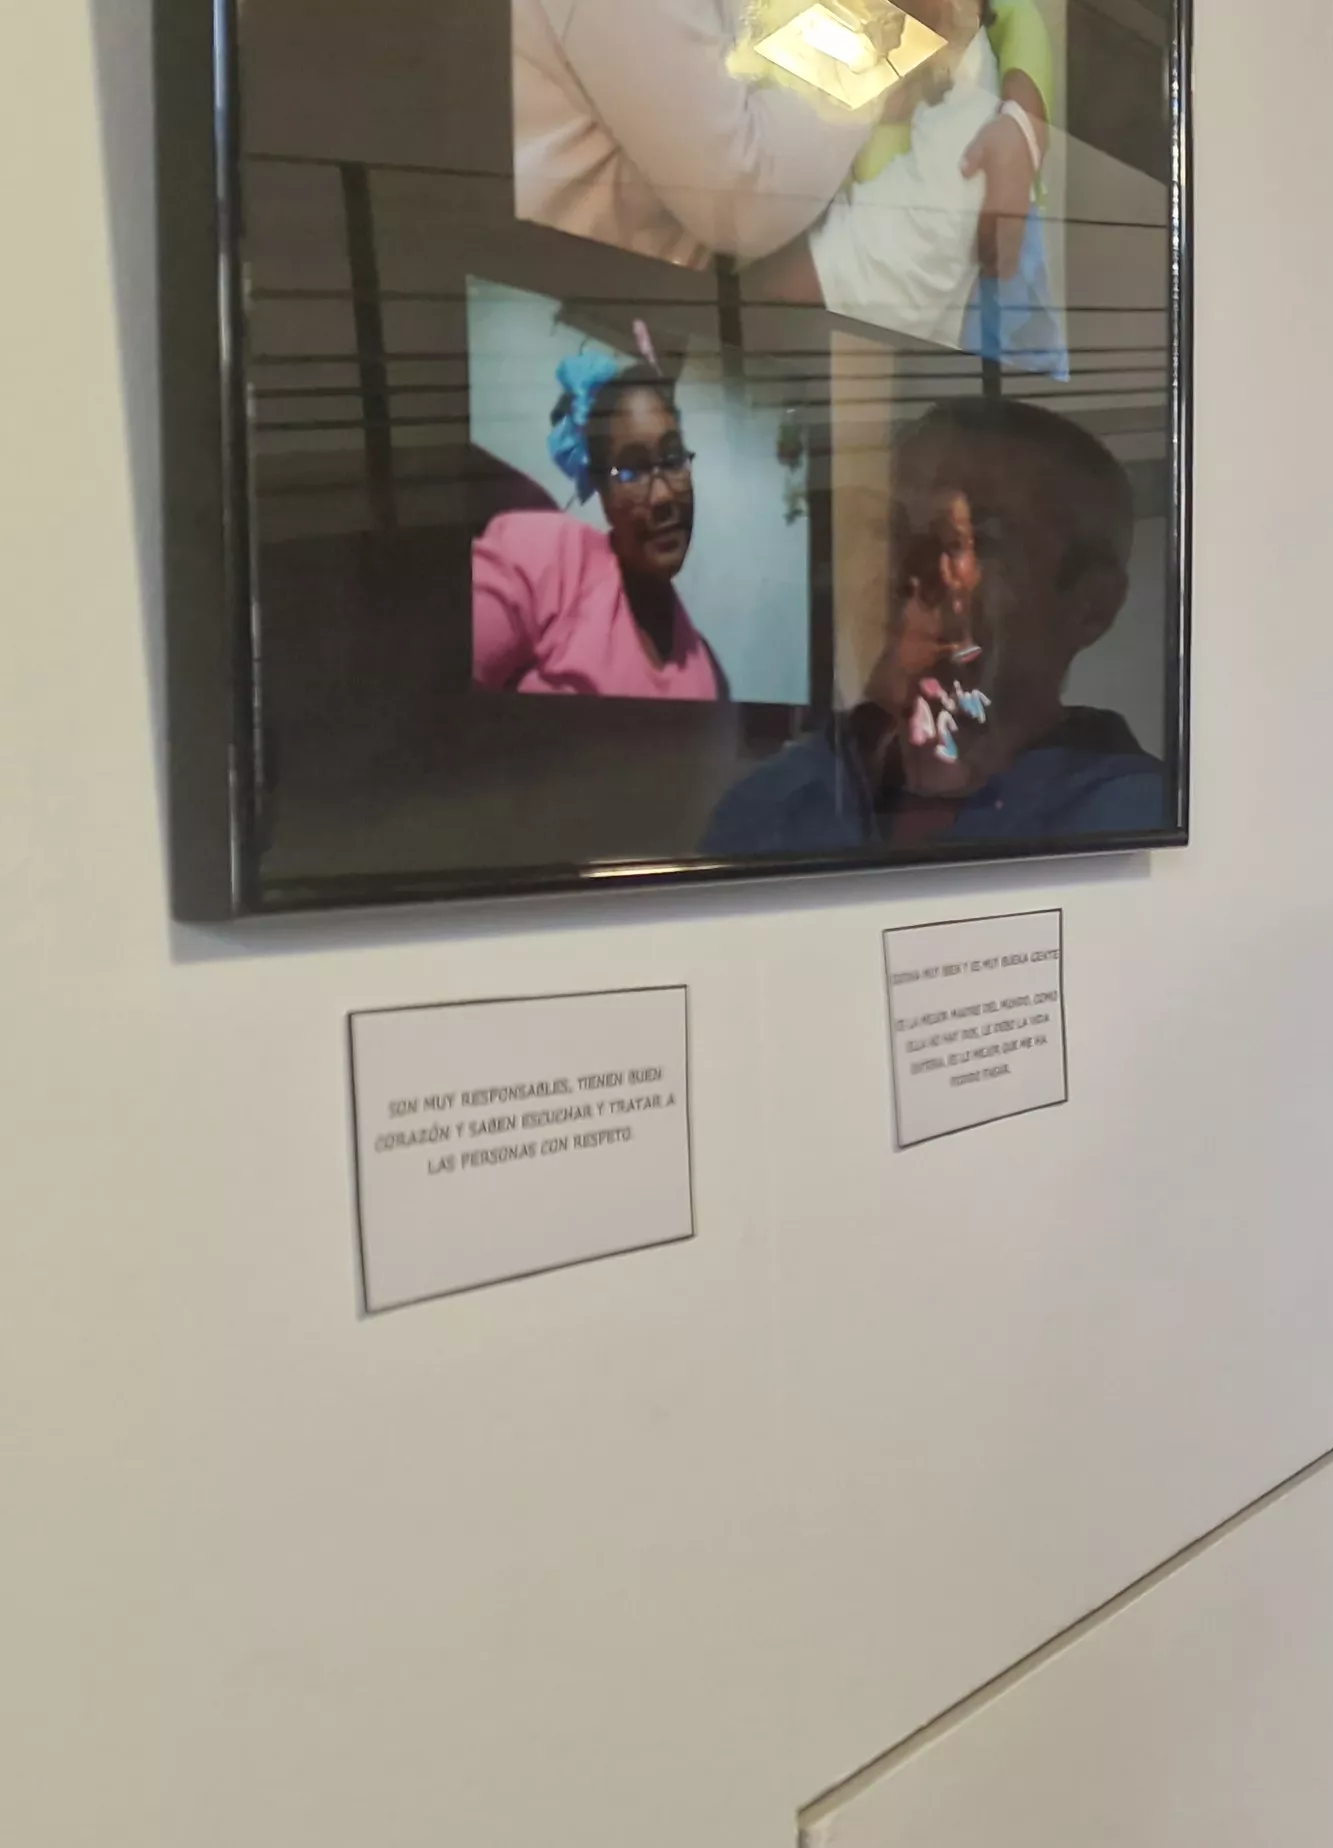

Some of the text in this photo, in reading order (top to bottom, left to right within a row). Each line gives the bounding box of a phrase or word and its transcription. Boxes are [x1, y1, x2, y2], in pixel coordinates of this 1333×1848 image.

[388, 1100, 417, 1119] SON
[424, 1093, 455, 1112] MUY
[578, 1073, 623, 1090] TIENEN
[629, 1067, 662, 1083] BUEN
[374, 1094, 676, 1153] CORAZÓN Y SABEN ESCUCHAR Y TRATAR A
[428, 1157, 455, 1175] LAS
[461, 1143, 536, 1169] PERSONAS
[540, 1138, 568, 1156] CON
